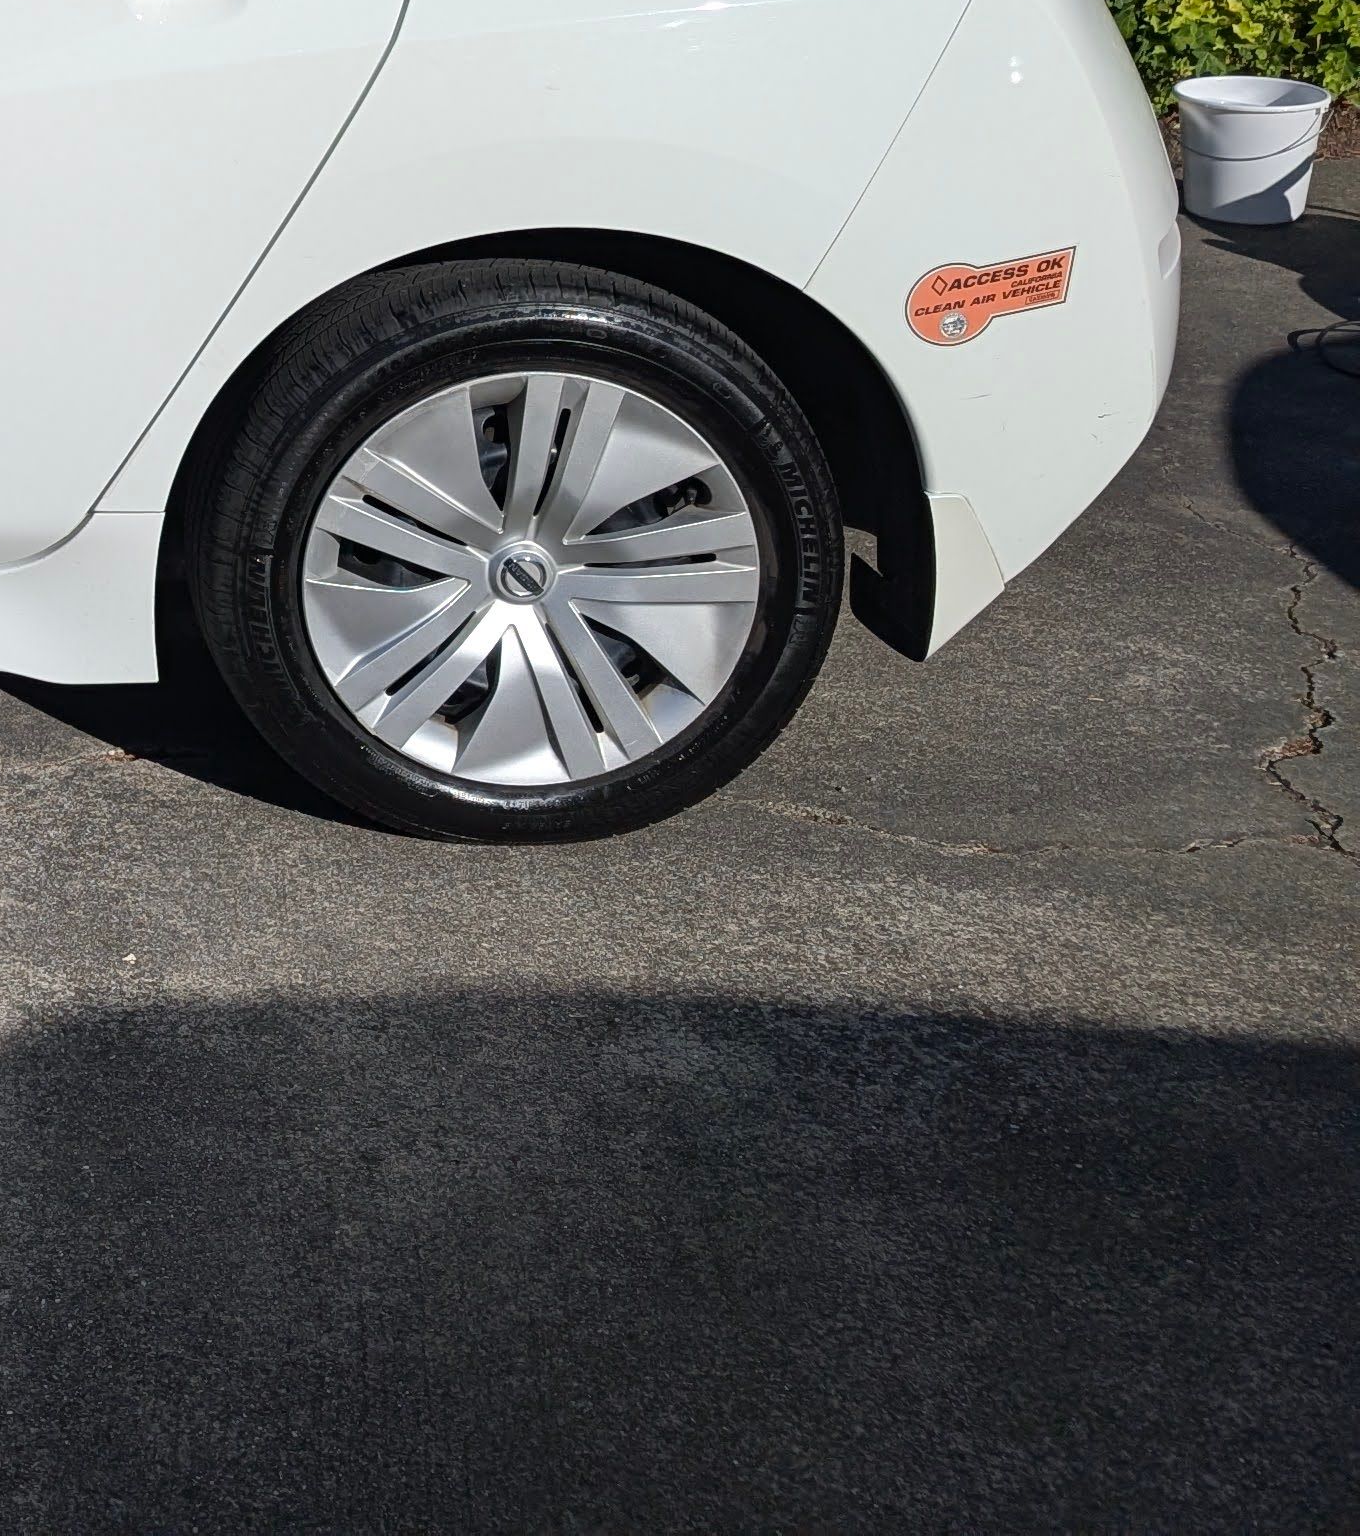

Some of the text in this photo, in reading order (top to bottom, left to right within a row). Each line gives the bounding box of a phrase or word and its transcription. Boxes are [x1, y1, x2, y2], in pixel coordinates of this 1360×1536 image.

[948, 256, 1066, 293] ACCESS OK
[1011, 271, 1063, 289] CALIFORNIA
[914, 300, 966, 317] CLEAN
[970, 293, 996, 307] AIR
[1002, 279, 1062, 300] VEHICLE
[782, 463, 818, 604] MICHELIN
